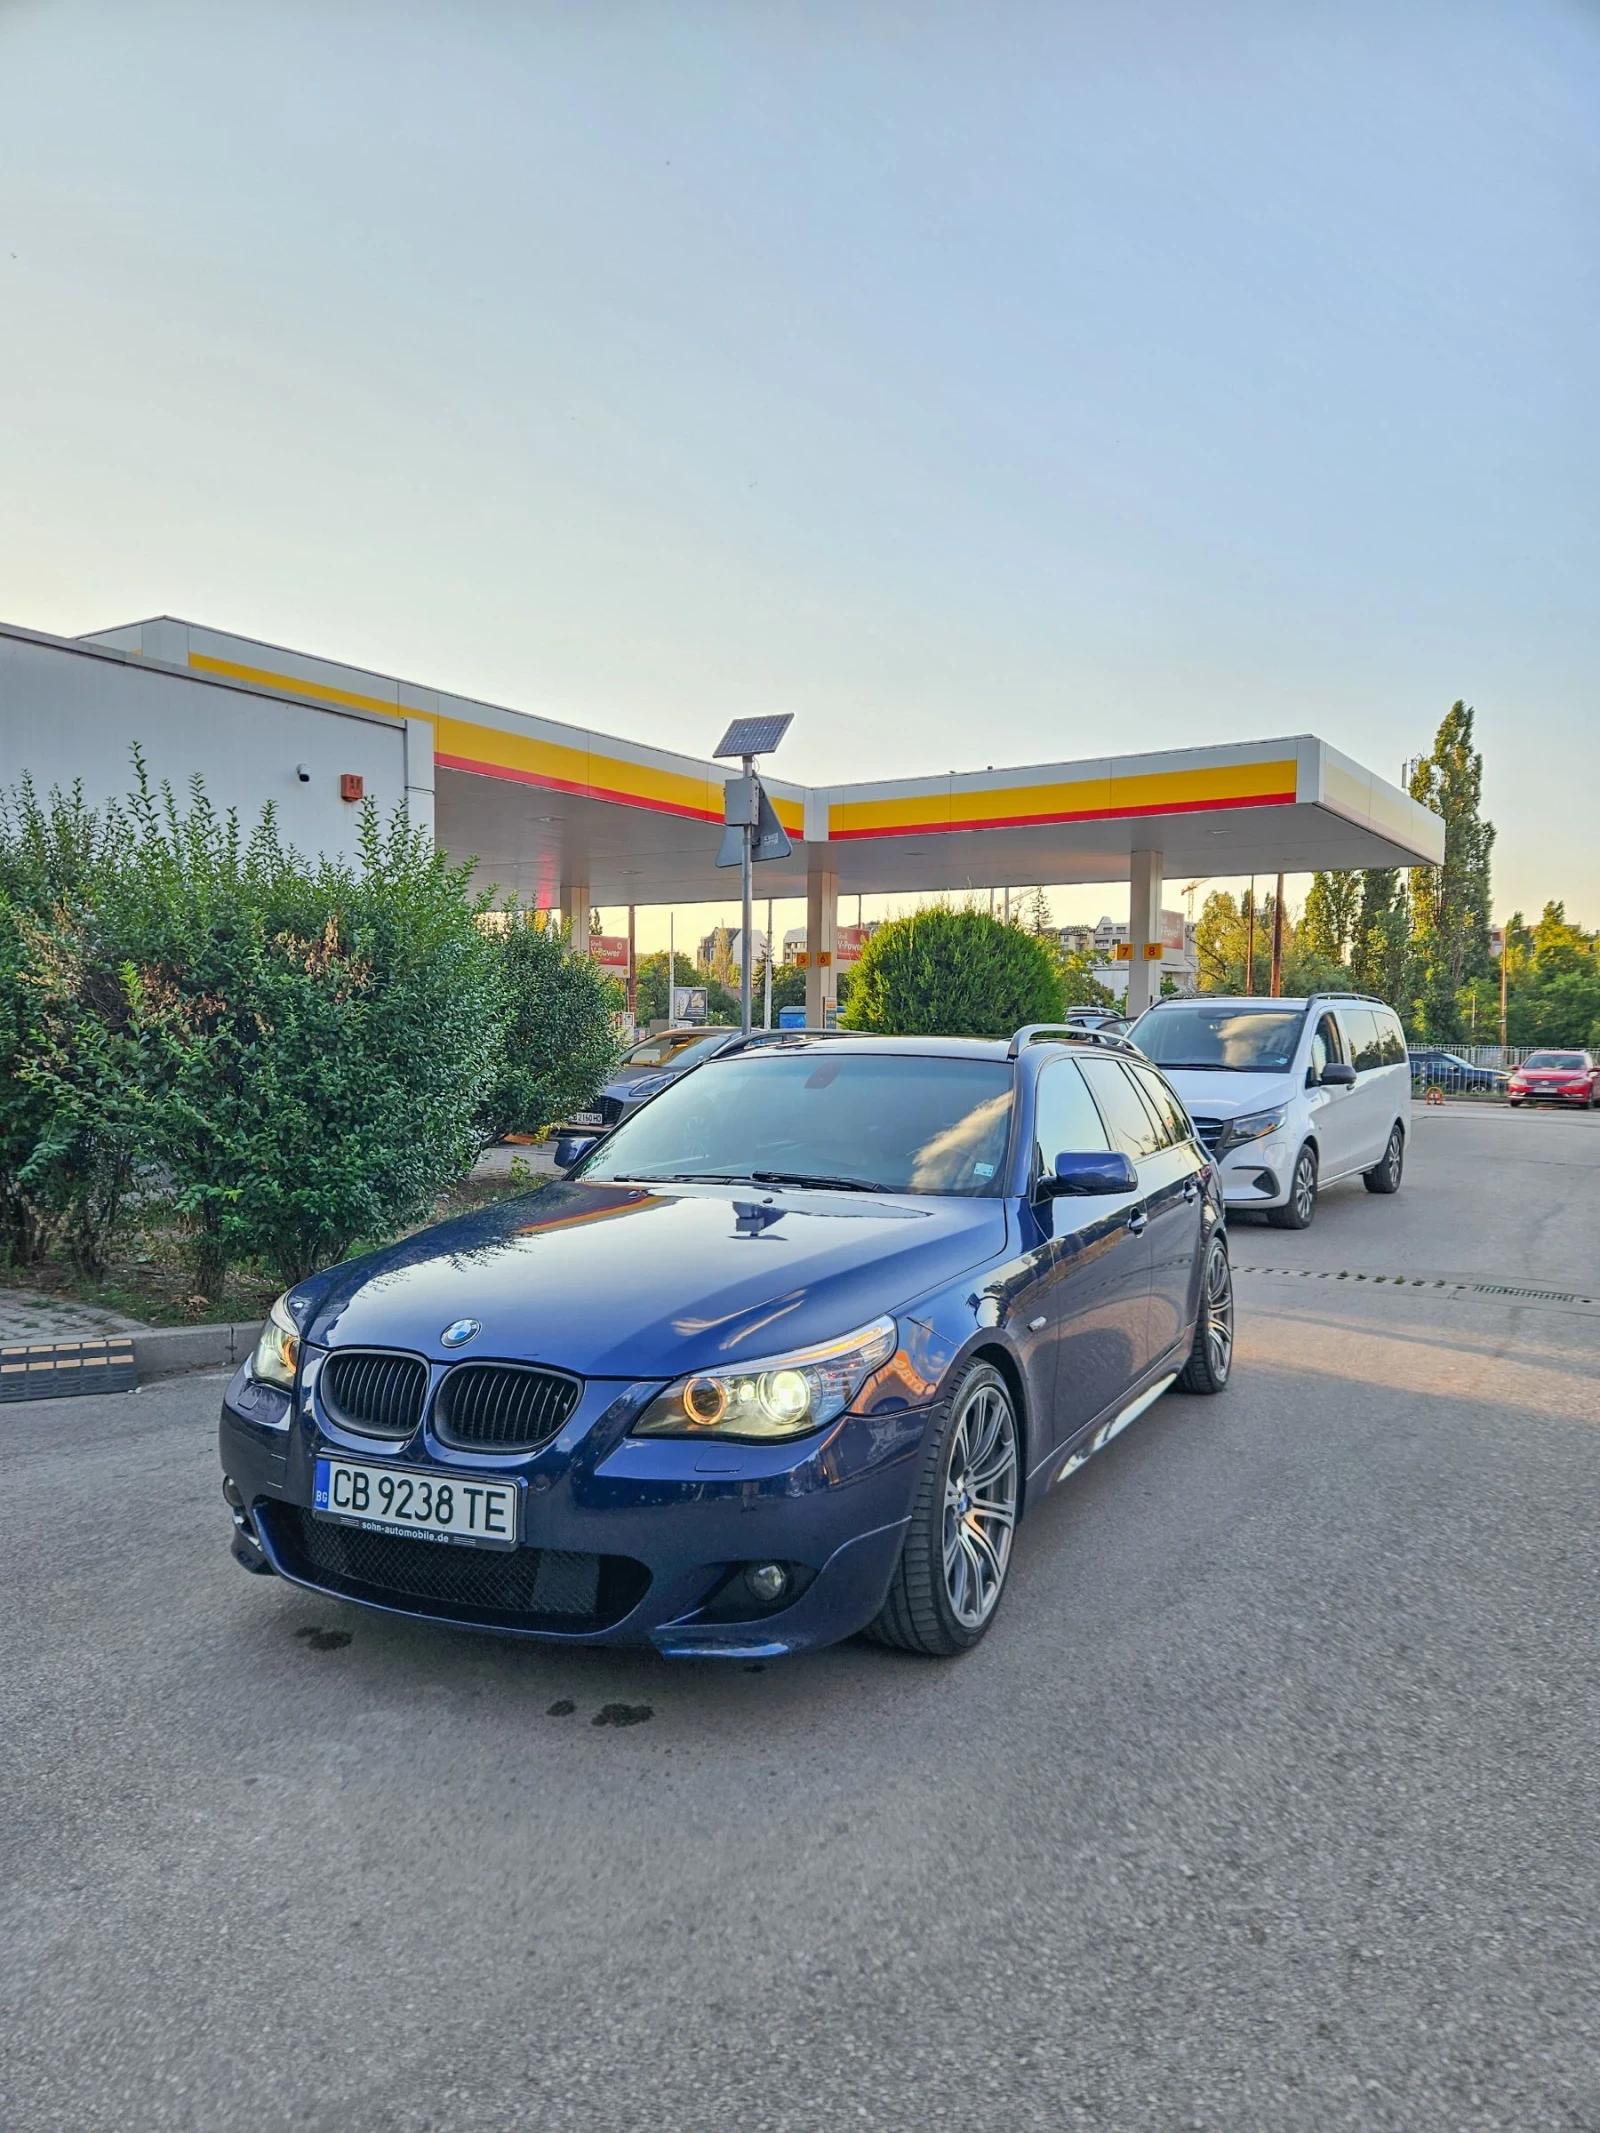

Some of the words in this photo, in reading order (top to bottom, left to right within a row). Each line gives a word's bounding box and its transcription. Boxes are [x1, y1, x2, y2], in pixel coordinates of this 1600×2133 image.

[838, 940, 862, 951] V-Powe
[1122, 947, 1129, 957] 7
[1148, 946, 1156, 956] 8
[800, 955, 806, 964] 5
[820, 955, 826, 964] 6
[316, 1490, 328, 1503] BG
[333, 1469, 370, 1511] CB
[378, 1476, 454, 1525] 9238
[463, 1487, 507, 1533] TE
[361, 1521, 449, 1543] sohn-automobile.de
